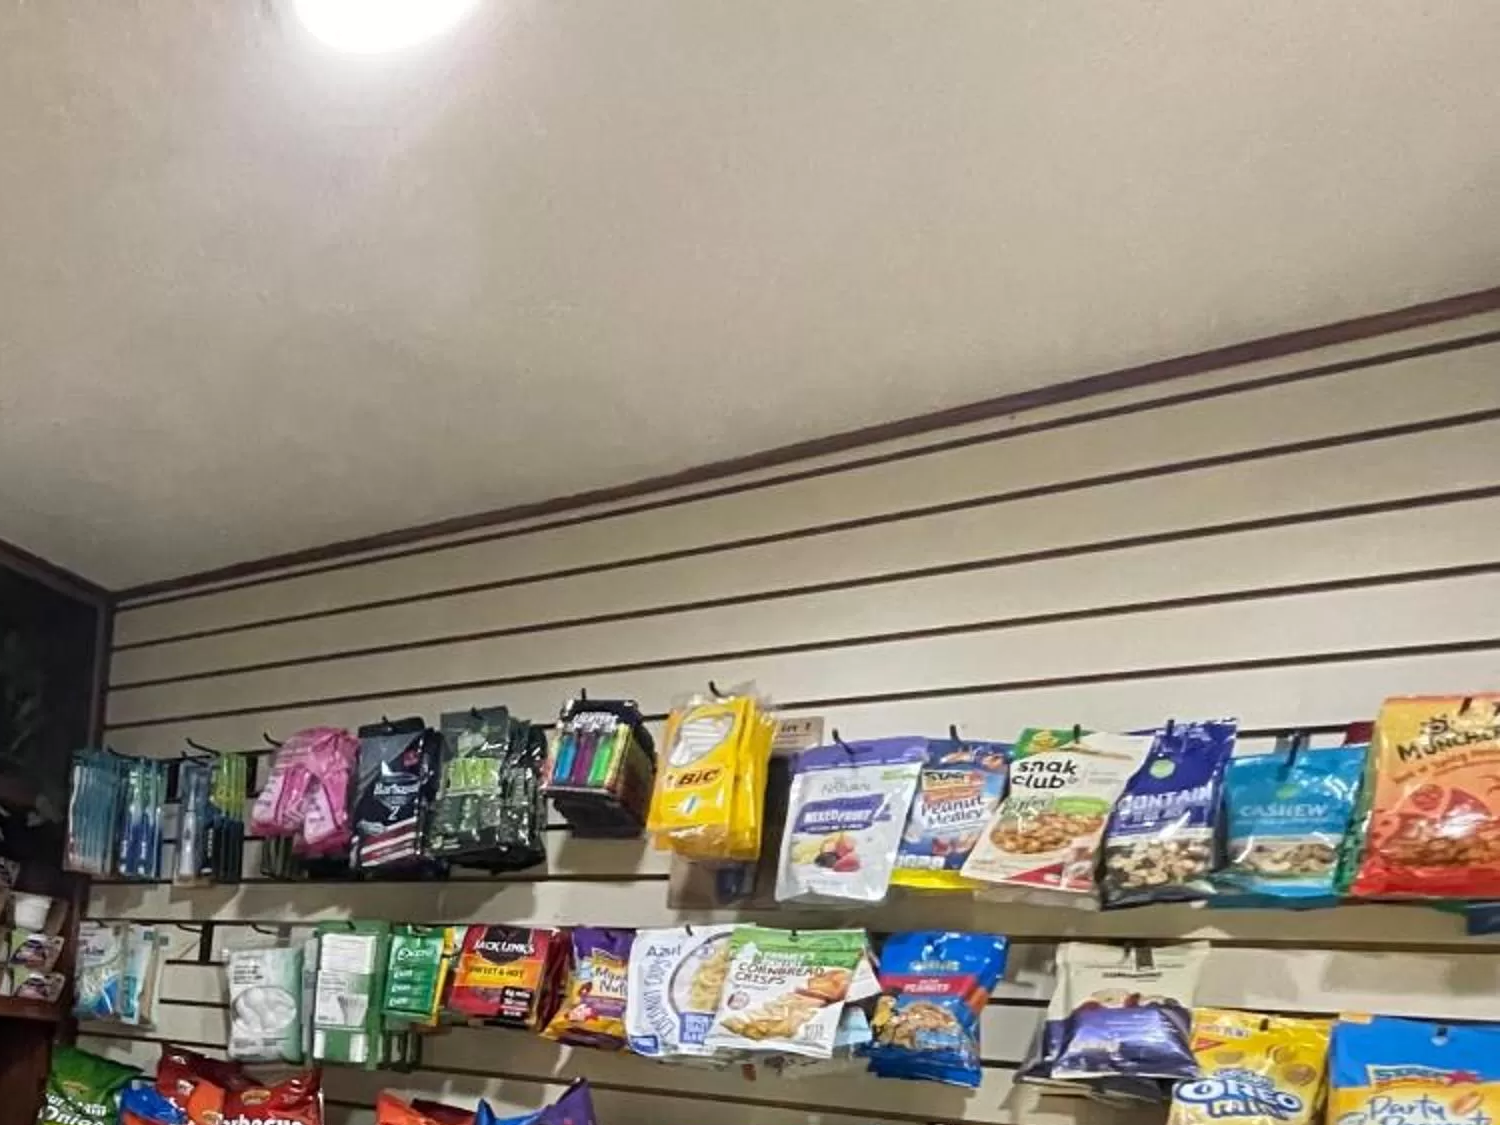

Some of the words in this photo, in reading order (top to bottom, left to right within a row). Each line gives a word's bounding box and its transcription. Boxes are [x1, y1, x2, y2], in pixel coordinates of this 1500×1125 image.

[1018, 758, 1078, 776] snak
[1011, 774, 1066, 790] club
[1240, 803, 1329, 817] CASHEW
[738, 962, 825, 977] CORNBREAD
[1174, 1078, 1302, 1112] OREO
[1366, 1093, 1446, 1120] Party
